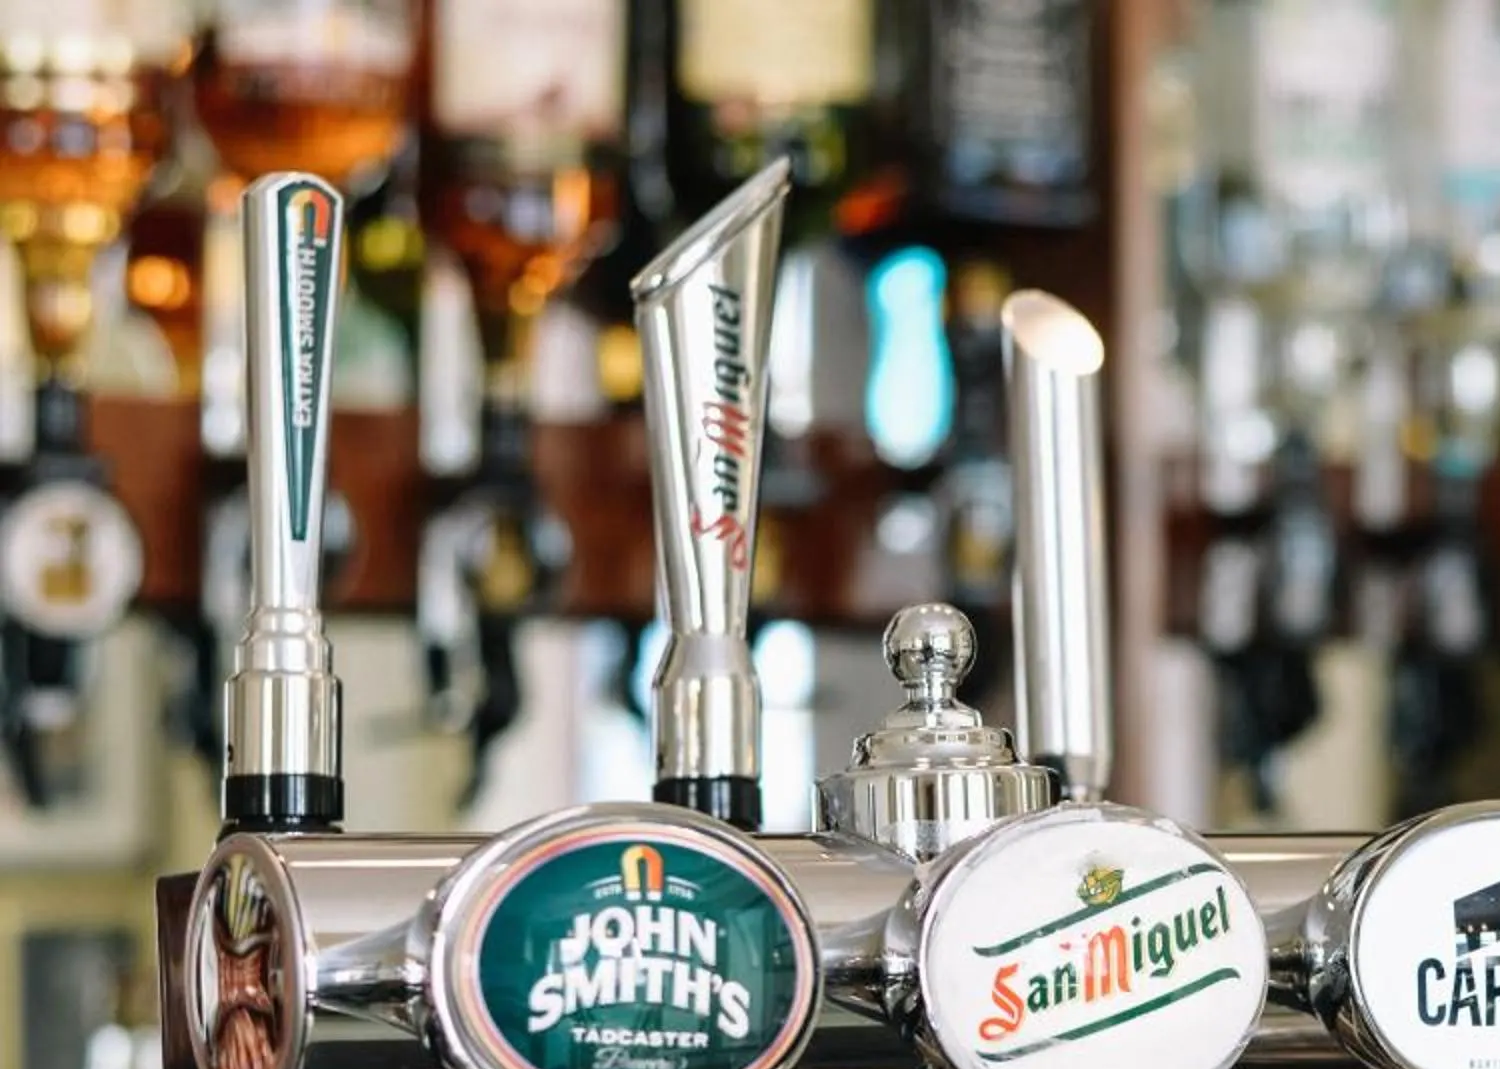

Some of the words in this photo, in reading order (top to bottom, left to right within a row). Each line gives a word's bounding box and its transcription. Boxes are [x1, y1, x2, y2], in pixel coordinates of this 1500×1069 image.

[297, 248, 317, 348] SMOOTH
[294, 353, 314, 428] EXTRA
[560, 905, 717, 967] JOHN
[527, 957, 751, 1040] SMITH'S
[571, 1027, 709, 1048] TADCASTER
